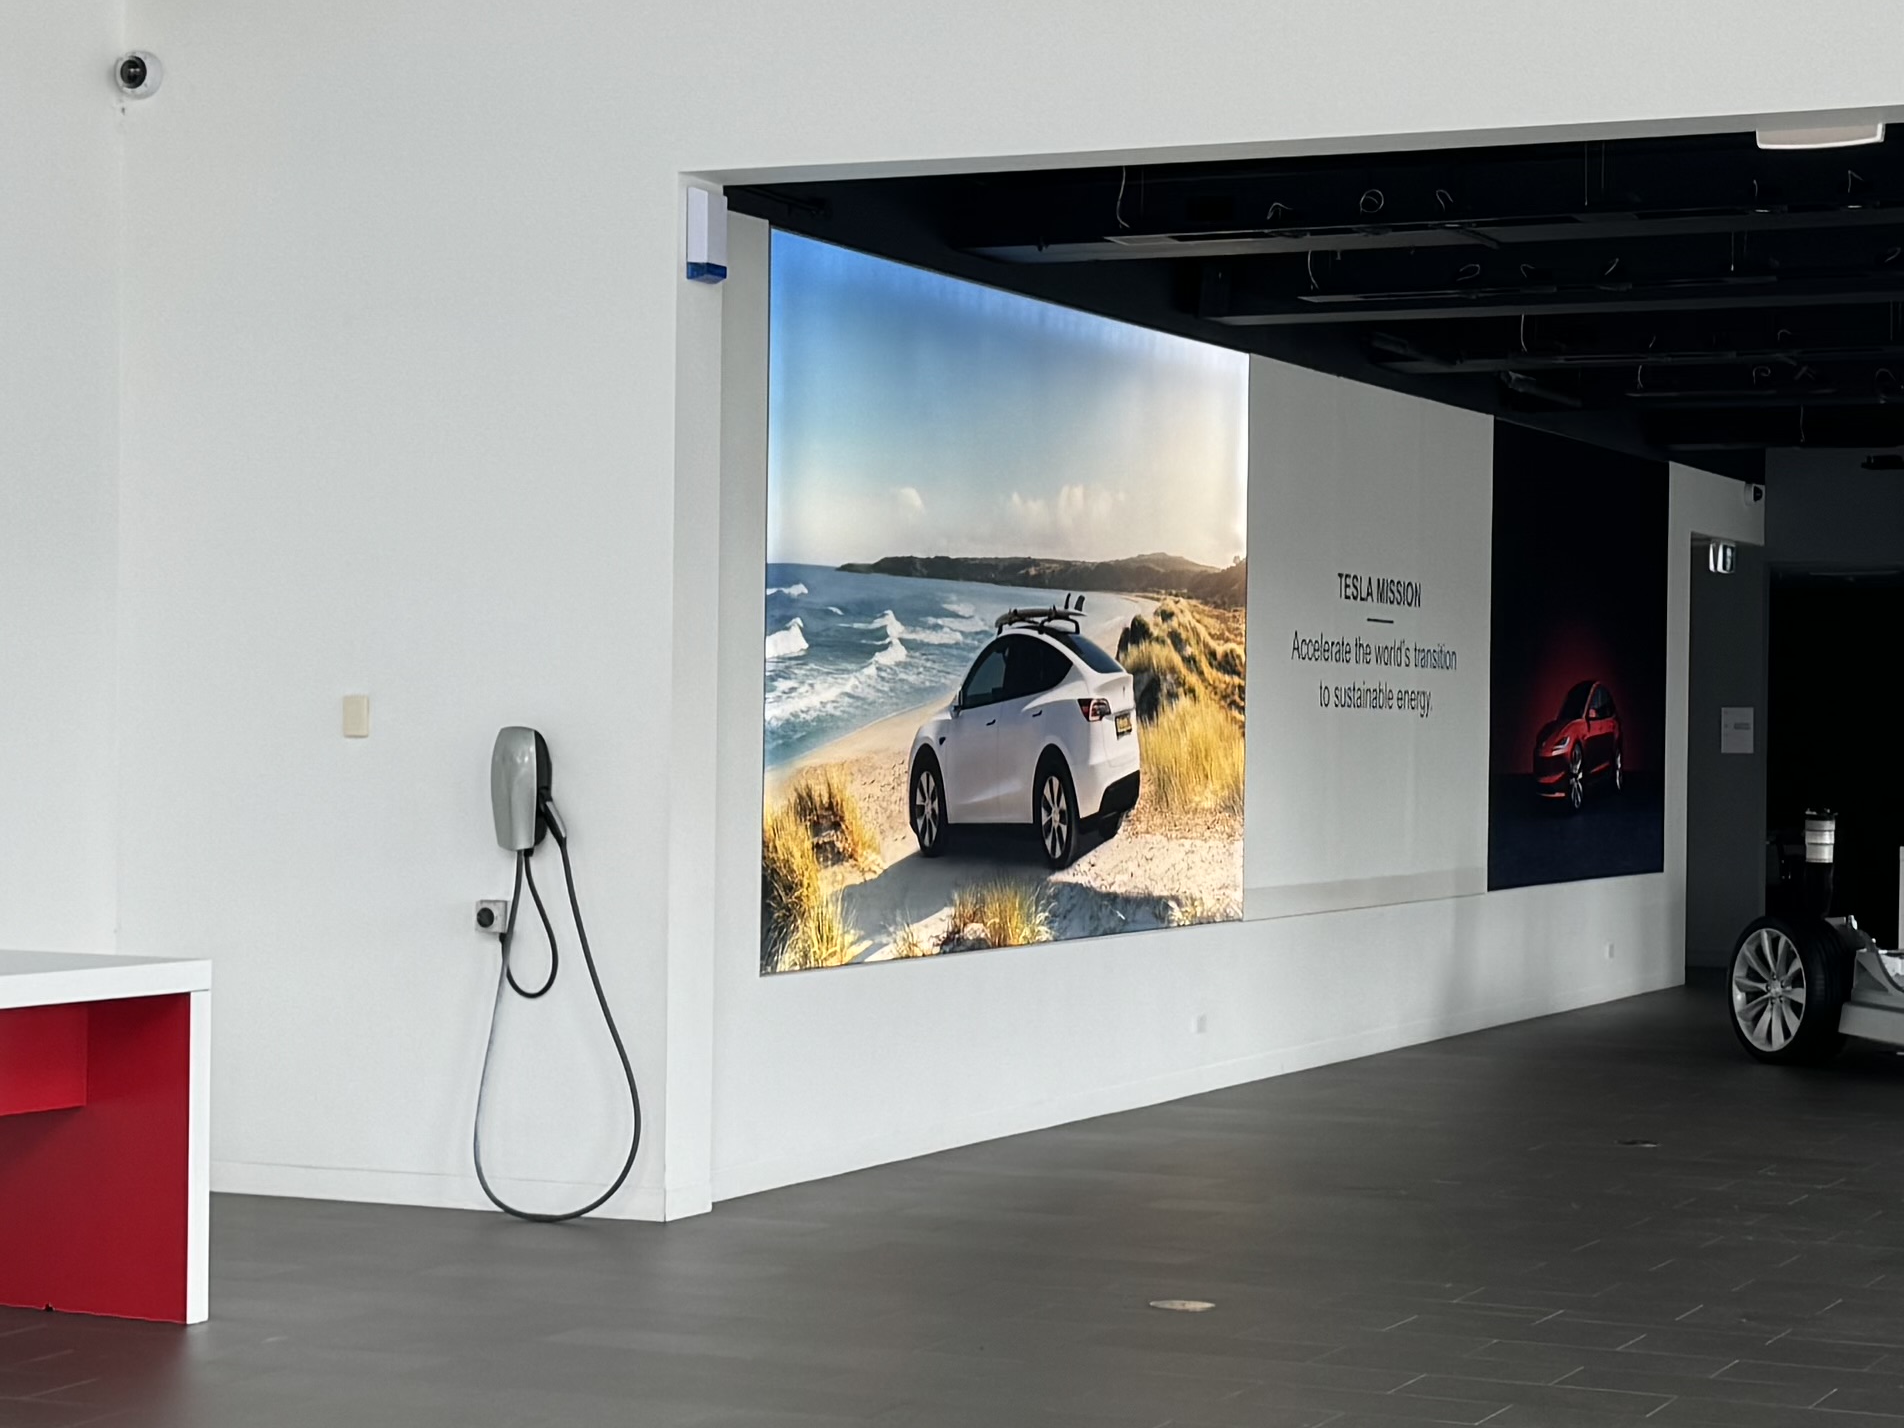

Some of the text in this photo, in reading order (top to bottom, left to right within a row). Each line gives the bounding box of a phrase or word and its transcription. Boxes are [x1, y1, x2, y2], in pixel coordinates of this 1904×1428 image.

[1338, 572, 1421, 608] TESLA MISSION
[1291, 630, 1351, 664] Accelerate
[1355, 636, 1371, 665] the
[1414, 642, 1457, 670] transition
[1319, 680, 1432, 718] to sustainable energy.
